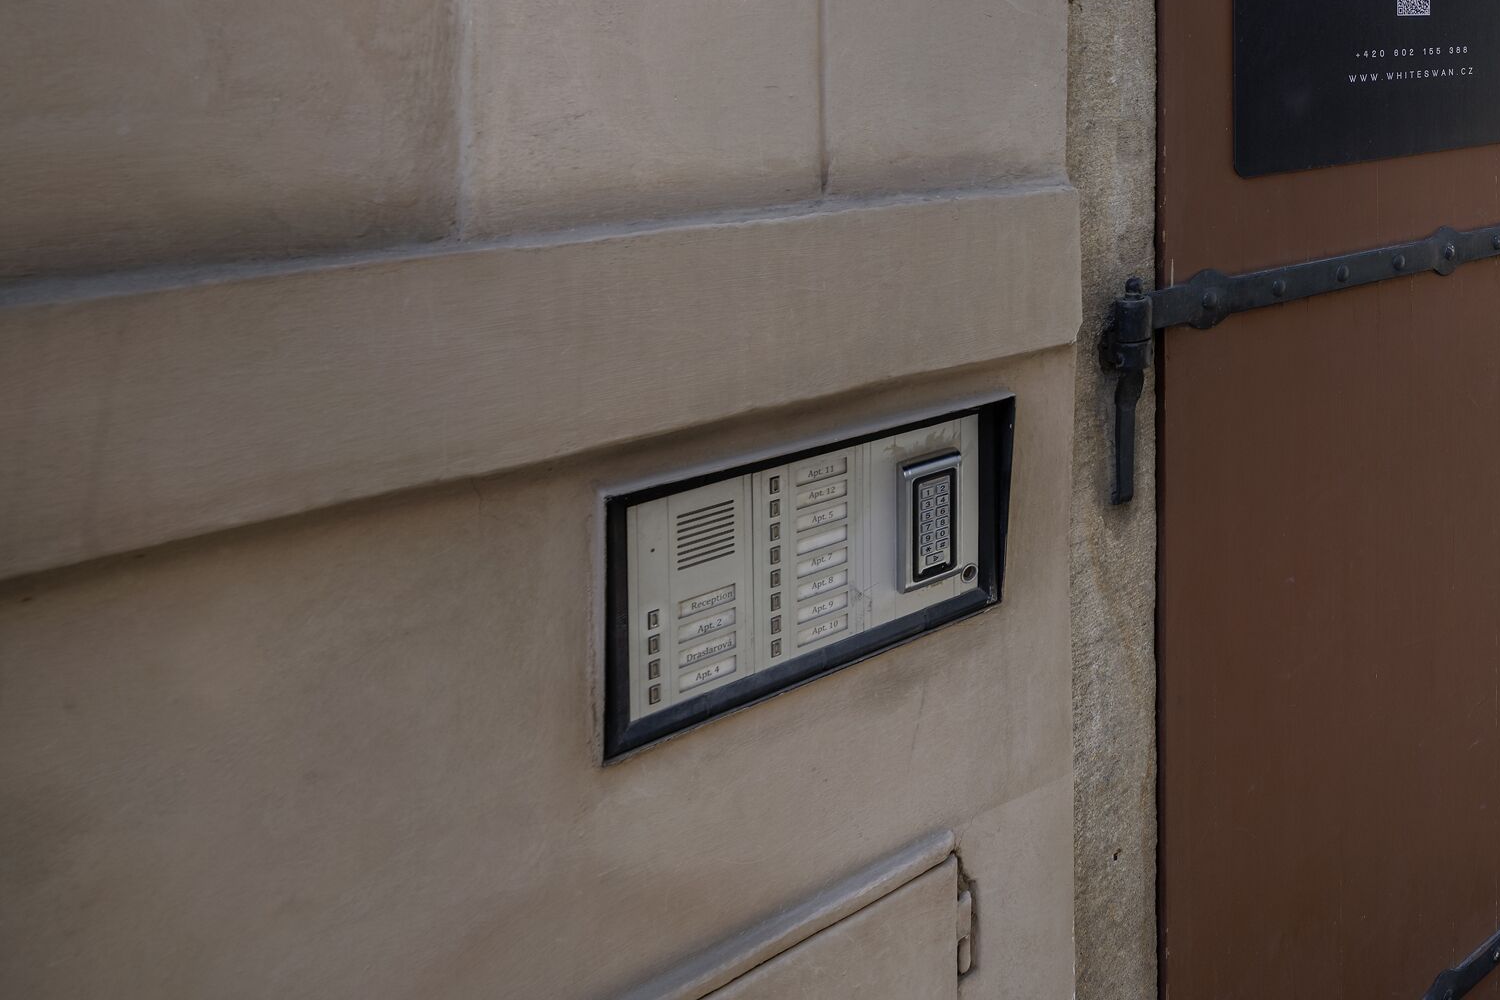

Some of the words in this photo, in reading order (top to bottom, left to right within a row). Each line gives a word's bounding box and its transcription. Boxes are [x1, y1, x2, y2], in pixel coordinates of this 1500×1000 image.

[1355, 49, 1385, 58] +420
[1348, 67, 1473, 83] WWW.WHITESWAN.CZ
[807, 468, 823, 479] Apt.
[825, 464, 834, 474] 11
[808, 490, 824, 500] Apt.
[826, 486, 836, 495] 12
[811, 514, 826, 523] Apt.
[828, 510, 834, 519] 5
[811, 556, 826, 567] Apt.
[827, 552, 833, 561] 7
[811, 580, 827, 590] Apt.
[828, 576, 834, 584] 8
[691, 590, 733, 611] Reception
[811, 604, 826, 615] Apt.
[828, 600, 834, 609] 9
[697, 622, 715, 634] Apt.
[716, 618, 722, 627] 2
[811, 625, 827, 635] Apt.
[829, 620, 839, 630] 10
[695, 669, 713, 681] Apt.
[714, 665, 720, 674] 4
